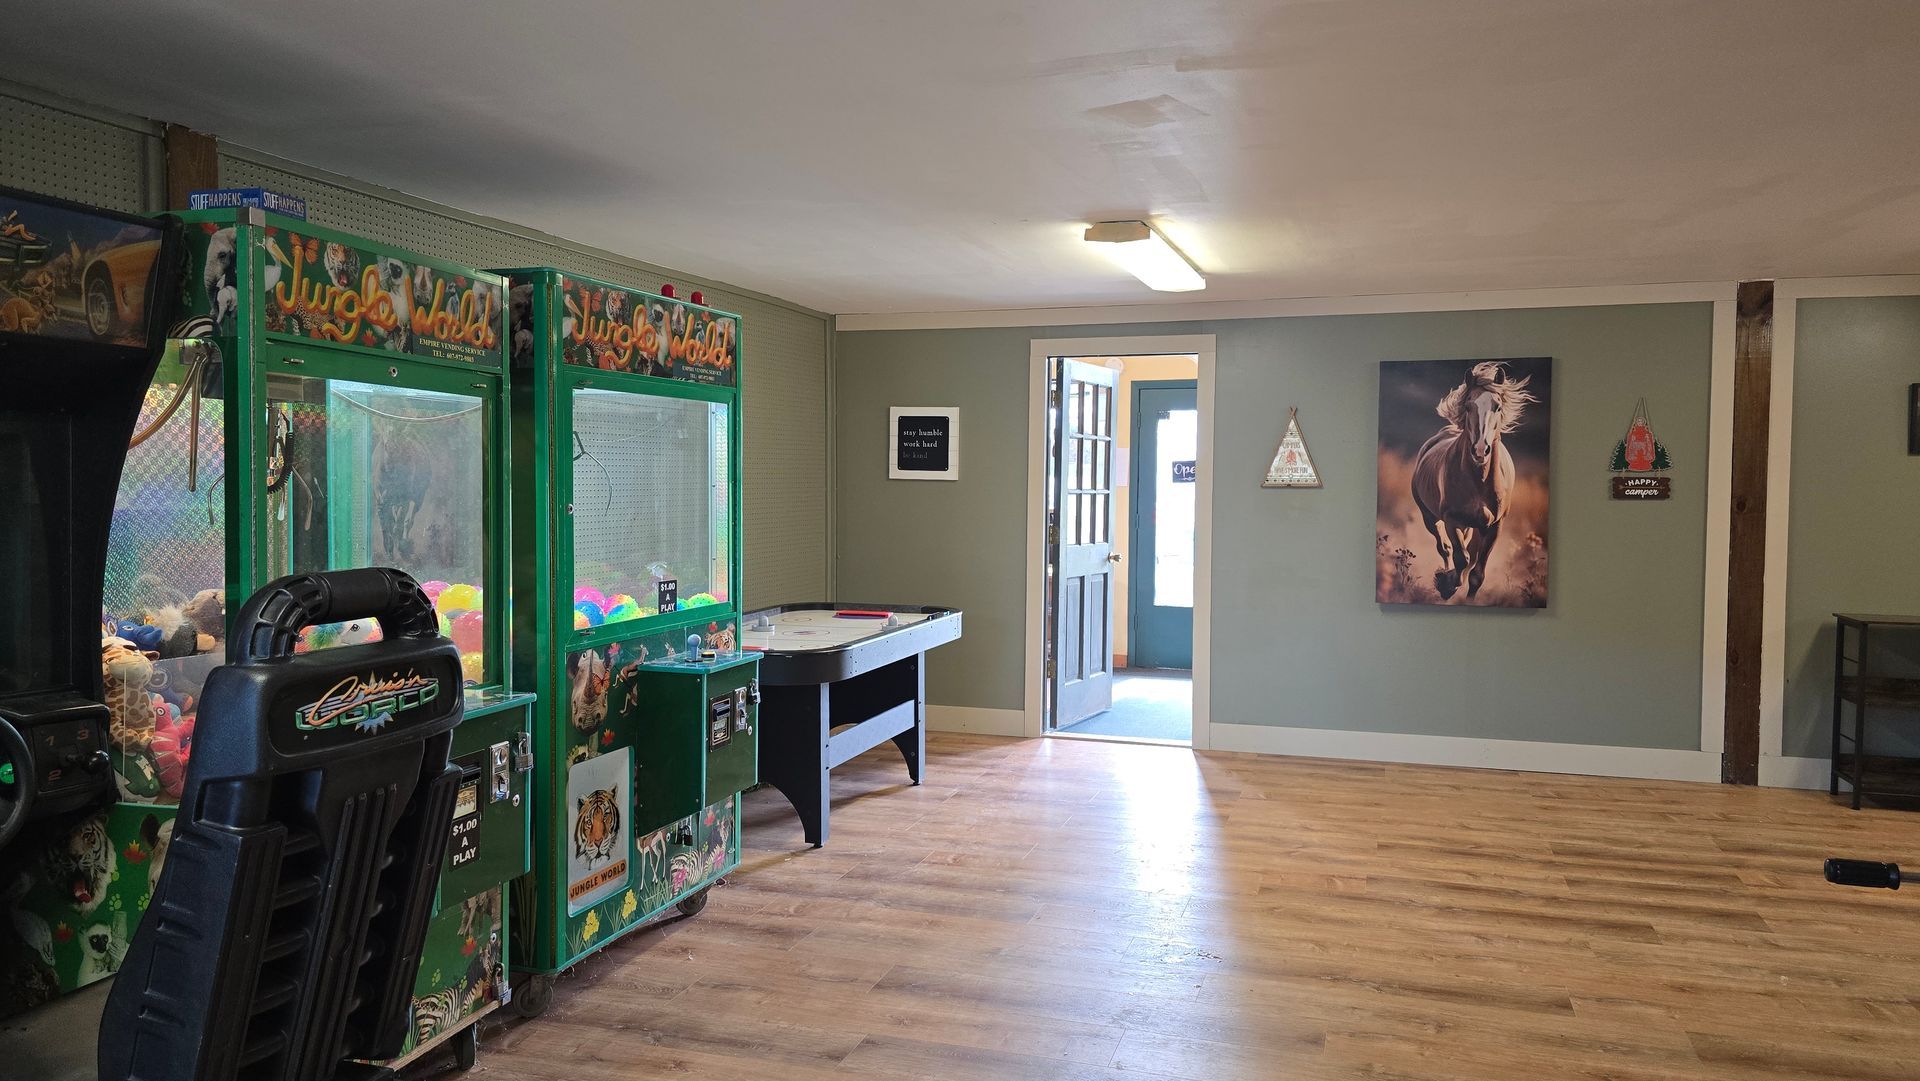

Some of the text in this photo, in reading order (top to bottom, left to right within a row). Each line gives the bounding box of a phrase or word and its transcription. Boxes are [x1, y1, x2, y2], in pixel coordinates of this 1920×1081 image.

[276, 244, 496, 349] Jungle World
[571, 290, 732, 368] Jungle World
[419, 337, 485, 356] EMPIRE VENDING SERVICE
[918, 428, 943, 436] humble
[903, 440, 938, 448] work hard
[1173, 463, 1196, 478] Ope
[1624, 488, 1659, 498] camper
[660, 582, 676, 592] $1.00
[665, 593, 671, 601] A
[660, 603, 675, 612] PLAY
[308, 667, 428, 726] Cruis'n
[295, 681, 440, 731] WORLD
[452, 818, 478, 837] $1.00
[461, 836, 469, 847] A
[453, 847, 477, 866] PLAY
[570, 863, 626, 899] JUNGLE WORLD
